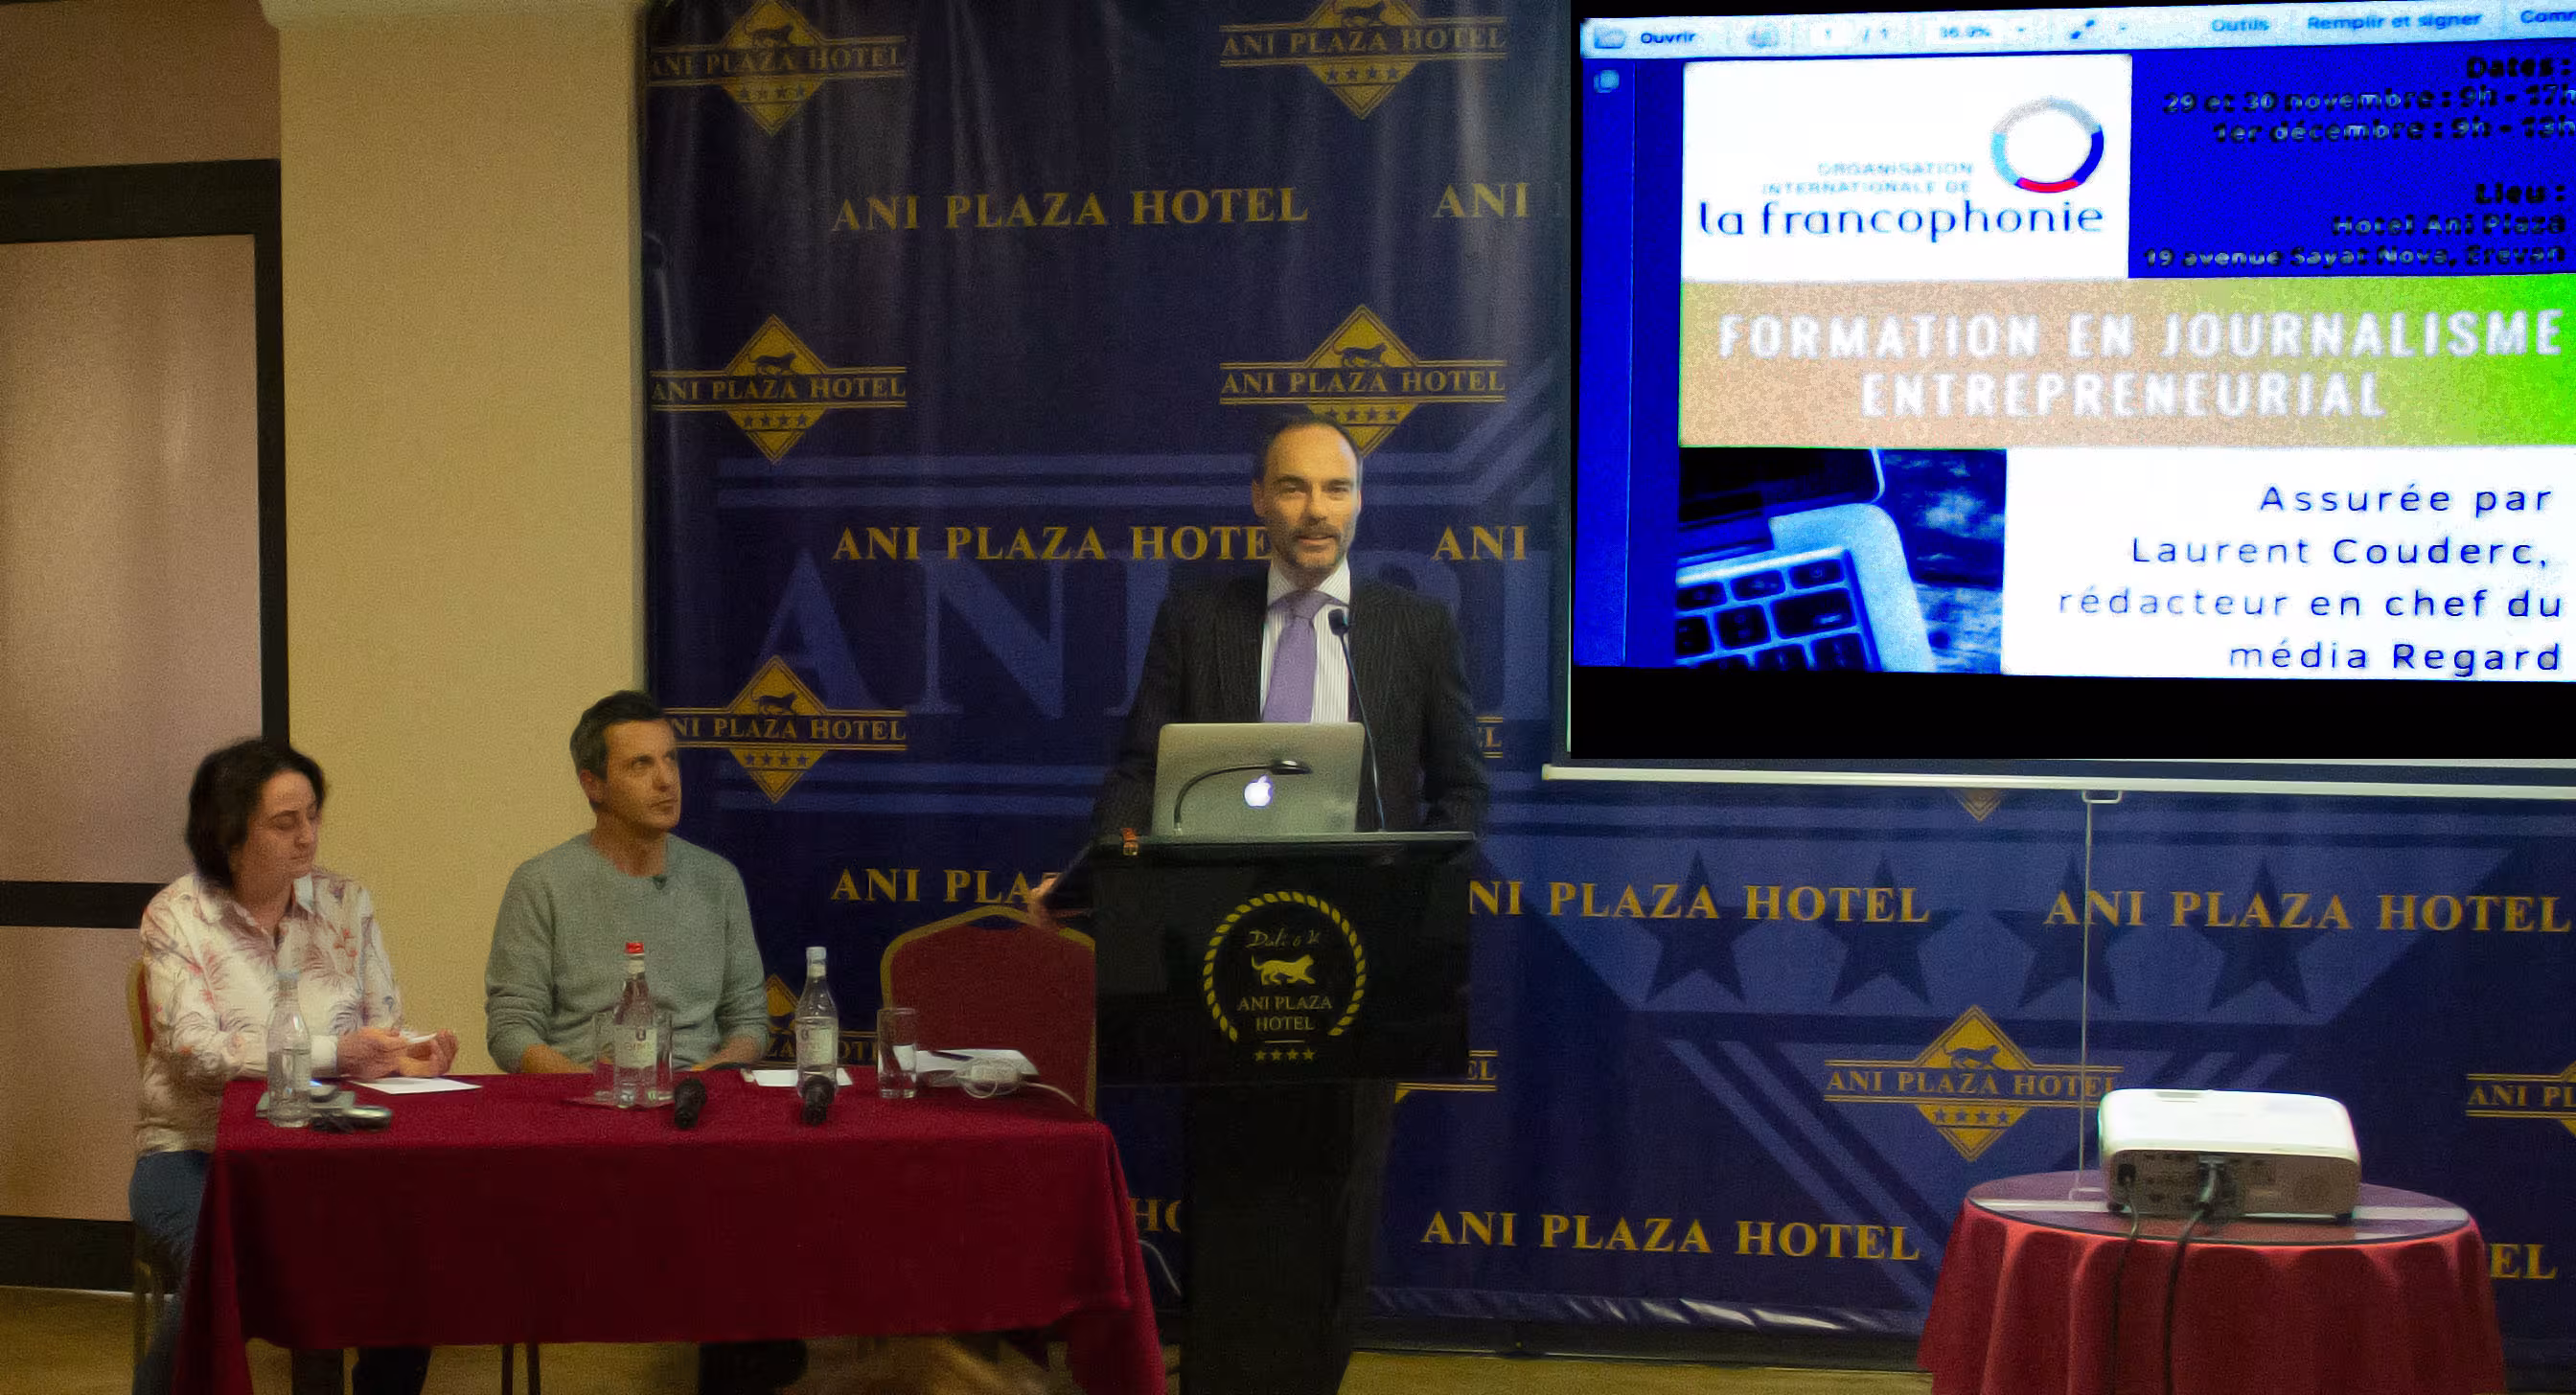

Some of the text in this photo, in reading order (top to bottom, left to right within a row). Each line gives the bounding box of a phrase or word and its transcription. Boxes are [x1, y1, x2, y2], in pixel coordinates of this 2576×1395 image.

[2211, 17, 2270, 33] Outils
[2308, 13, 2483, 32] Remplir et signer
[1223, 25, 1506, 56] ANI PLAZA HOTEL
[1640, 31, 1696, 45] Ouvrir
[706, 53, 795, 74] PLAZA
[809, 47, 905, 69] HOTEL
[2467, 57, 2554, 79] Dates
[2164, 93, 2196, 114] 29
[2243, 92, 2279, 112] 30
[2285, 88, 2434, 112] novembre
[2459, 84, 2496, 106] 9h
[2214, 122, 2262, 142] 1er
[2271, 118, 2425, 142] décembre
[2451, 116, 2491, 138] 9h
[1433, 181, 1530, 219] ANI
[2475, 183, 2544, 204] Lieu
[832, 188, 1308, 232] ANI PLAZA HOTEL
[1700, 199, 2104, 242] la francophonie
[2333, 213, 2566, 235] Hotel Ani Plaza
[2145, 248, 2174, 265] 19
[2183, 250, 2283, 266] avenue
[2290, 246, 2369, 269] Sayat
[2466, 245, 2566, 265] Erevan
[1718, 309, 2564, 359] FORMATION EN JOURNALISME
[652, 377, 907, 400] ANI PLAZA HOTEL
[1222, 370, 1506, 394] ANI PLAZA HOTEL
[1861, 370, 2386, 418] ENTREPRENEURIAL
[2260, 483, 2553, 518] Assurée par
[832, 526, 1273, 560] ANI PLAZA HOTE
[1432, 526, 1529, 560] ANI
[2133, 537, 2548, 568] Laurent Couderc,
[2059, 584, 2562, 618] rédacteur en chef du
[2229, 636, 2563, 677] média Regard
[671, 718, 907, 741] NI PLAZA HOTEL
[830, 868, 920, 902] ANI
[1469, 880, 1931, 924] NI PLAZA HOTEL
[2043, 890, 2572, 932] ANI PLAZA HOTEL
[1237, 995, 1332, 1011] ANI PLAZA
[1256, 1017, 1315, 1031] HOTEL
[1826, 1070, 1882, 1091] ANI
[1898, 1072, 1998, 1094] PLAZA
[2469, 1085, 2527, 1107] ANI
[1421, 1212, 1920, 1260] ANI PLAZA HOTEL
